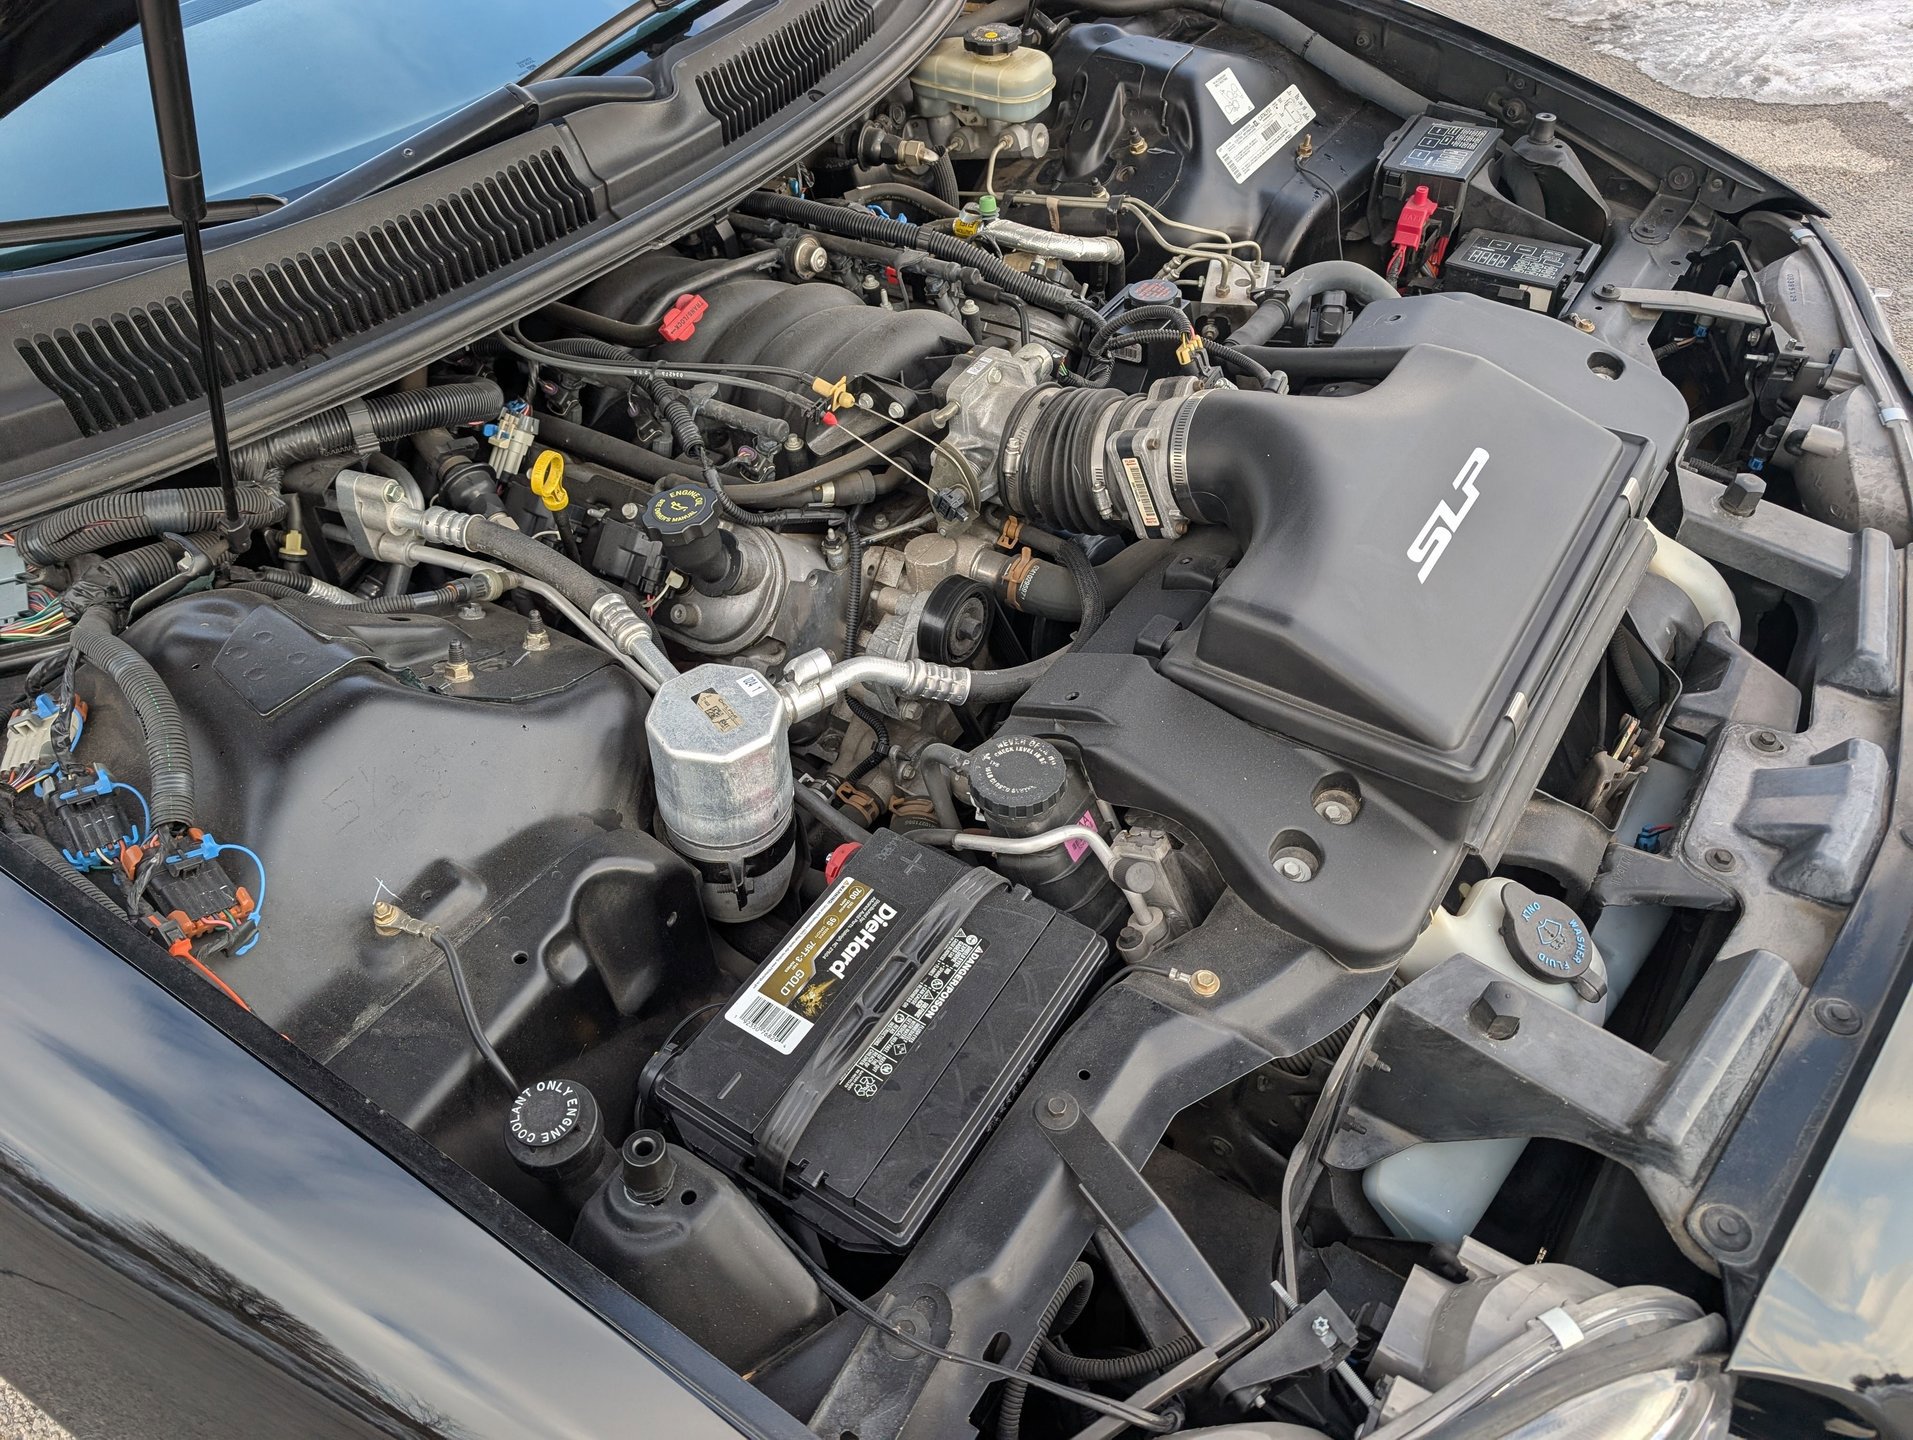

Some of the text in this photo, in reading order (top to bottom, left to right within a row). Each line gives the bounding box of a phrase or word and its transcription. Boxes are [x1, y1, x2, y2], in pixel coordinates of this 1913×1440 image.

[670, 490, 703, 507] ENGINE OIL
[672, 511, 697, 522] MANUAL
[1407, 448, 1490, 584] SLP
[994, 747, 1014, 757] CHECK
[1016, 746, 1033, 754] LEVEL
[996, 739, 1026, 749] NEVER
[848, 887, 862, 900] 700
[862, 896, 876, 910] Advance
[825, 916, 837, 927] 95
[1521, 901, 1540, 922] ONLY
[794, 940, 816, 962] 75FT-3
[827, 902, 897, 981] DieHard
[1538, 918, 1585, 970] WASHER FLUID
[779, 968, 805, 996] GOLD
[925, 952, 979, 1019] DANGER/POISON
[510, 1080, 577, 1142] ENGINE COOLANT ONLY
